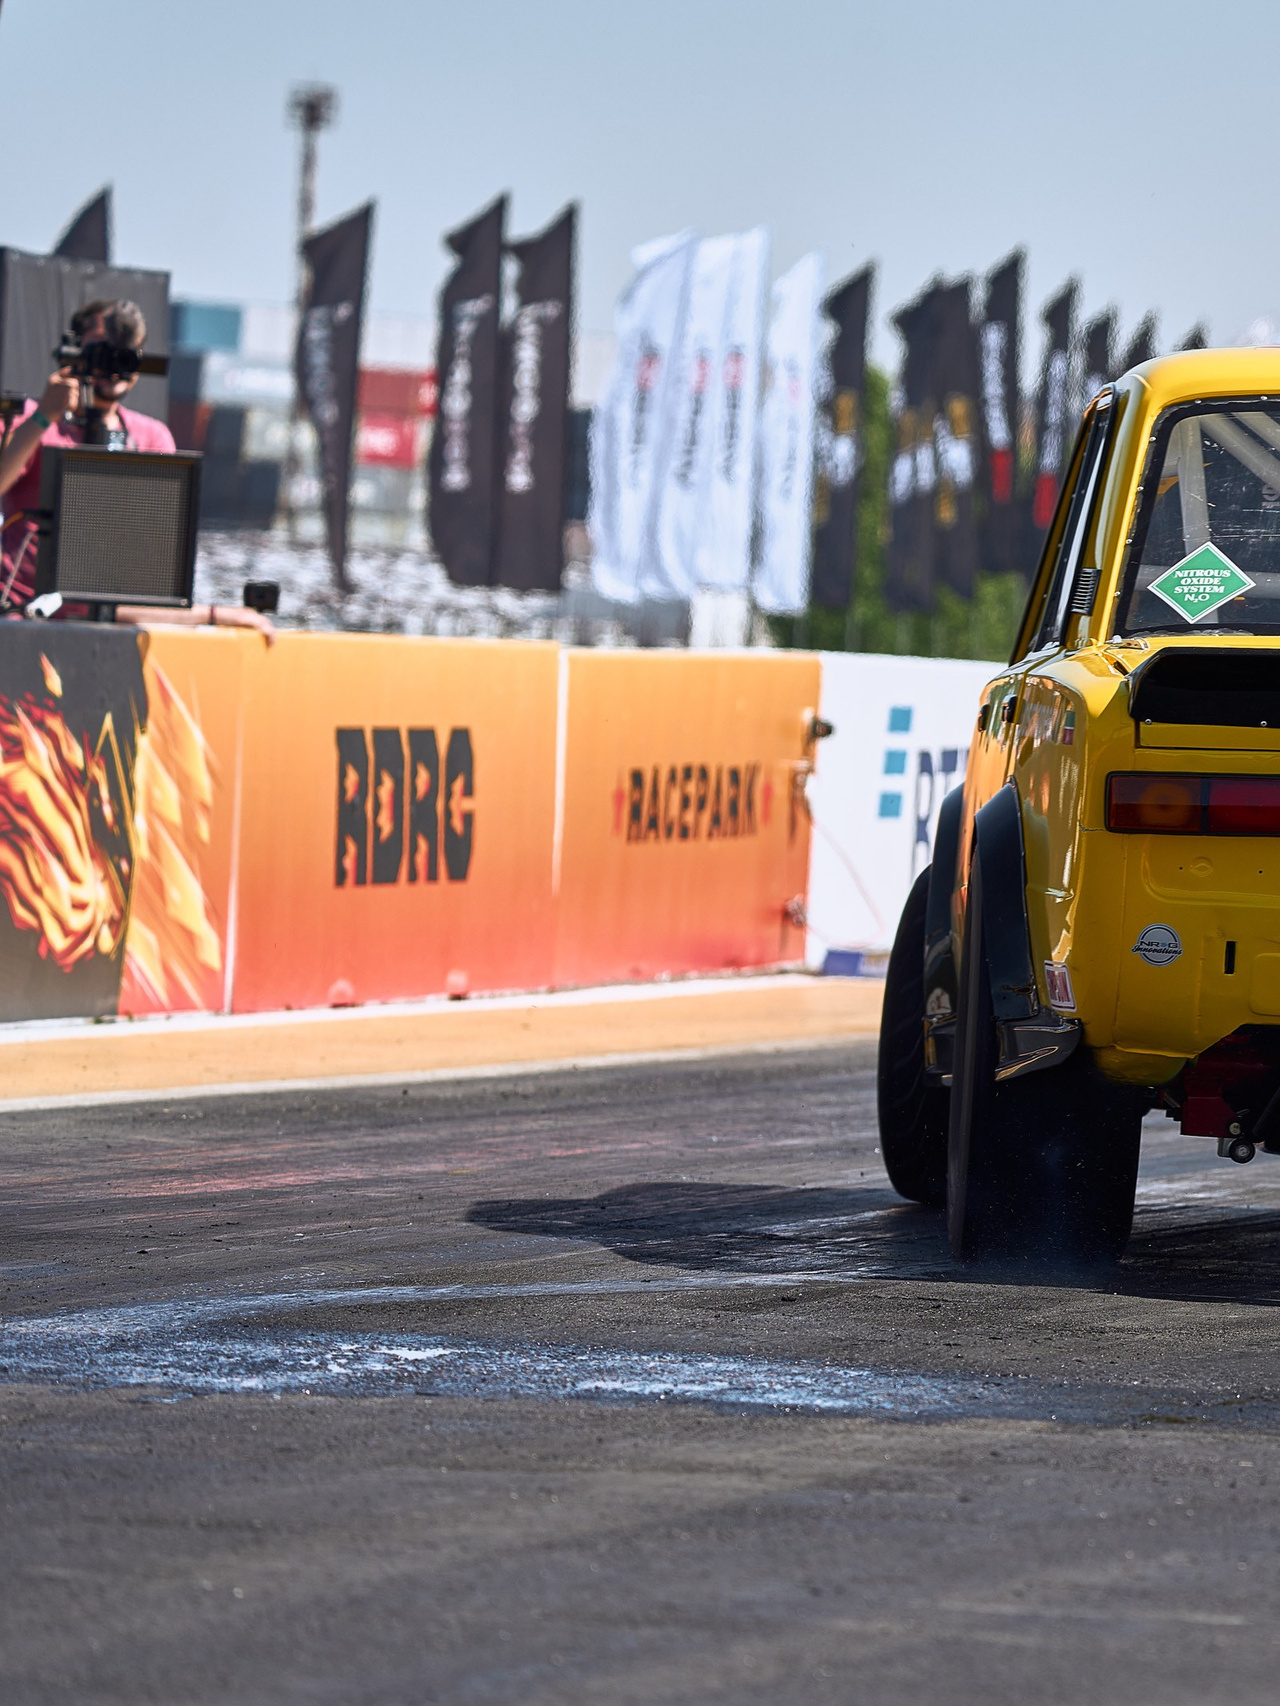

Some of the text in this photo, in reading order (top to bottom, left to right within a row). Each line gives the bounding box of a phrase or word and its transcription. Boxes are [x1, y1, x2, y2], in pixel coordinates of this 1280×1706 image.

[1174, 569, 1231, 578] NITROUS
[1174, 586, 1225, 594] SYSTEM
[626, 762, 761, 845] RACEPARK
[1131, 945, 1182, 954] Innovations
